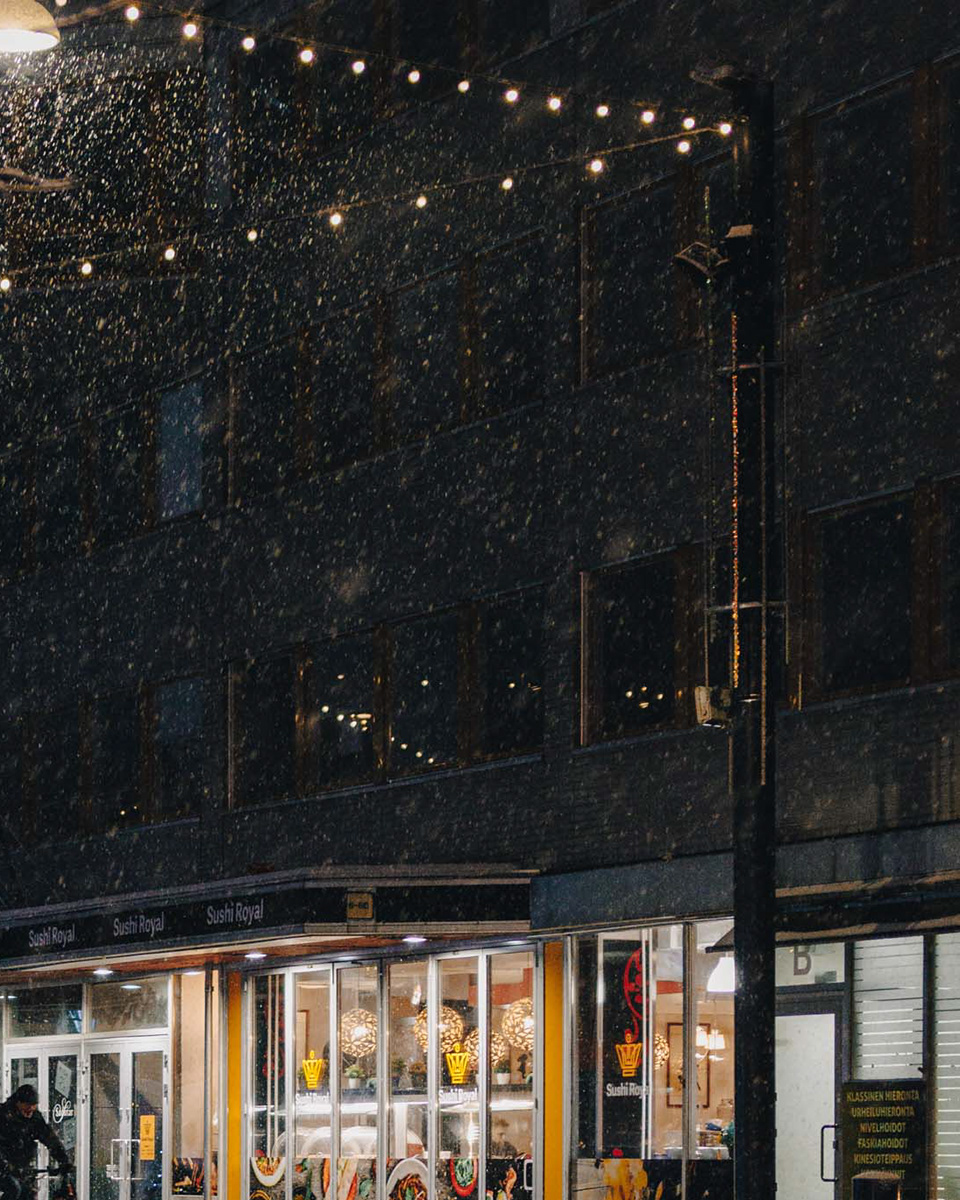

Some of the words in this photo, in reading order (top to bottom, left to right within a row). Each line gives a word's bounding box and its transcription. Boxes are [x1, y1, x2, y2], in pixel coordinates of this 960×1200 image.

[207, 903, 234, 925] Sushi
[235, 898, 264, 926] Royal
[113, 917, 138, 937] Sushi
[139, 912, 164, 937] Royal
[28, 926, 52, 947] Sushi
[52, 923, 75, 948] Royal
[793, 944, 812, 976] B
[606, 1082, 628, 1097] Sushi
[629, 1082, 651, 1099] Roya
[846, 1091, 884, 1102] KLASSINEN
[885, 1090, 920, 1101] HIERONTA
[851, 1106, 915, 1117] URHEILUHIERONTA
[859, 1122, 906, 1133] NIVELHOIDOT
[857, 1138, 908, 1149] FASKIAHOIDOT
[853, 1153, 913, 1164] KINESIOTEIPPAUS
